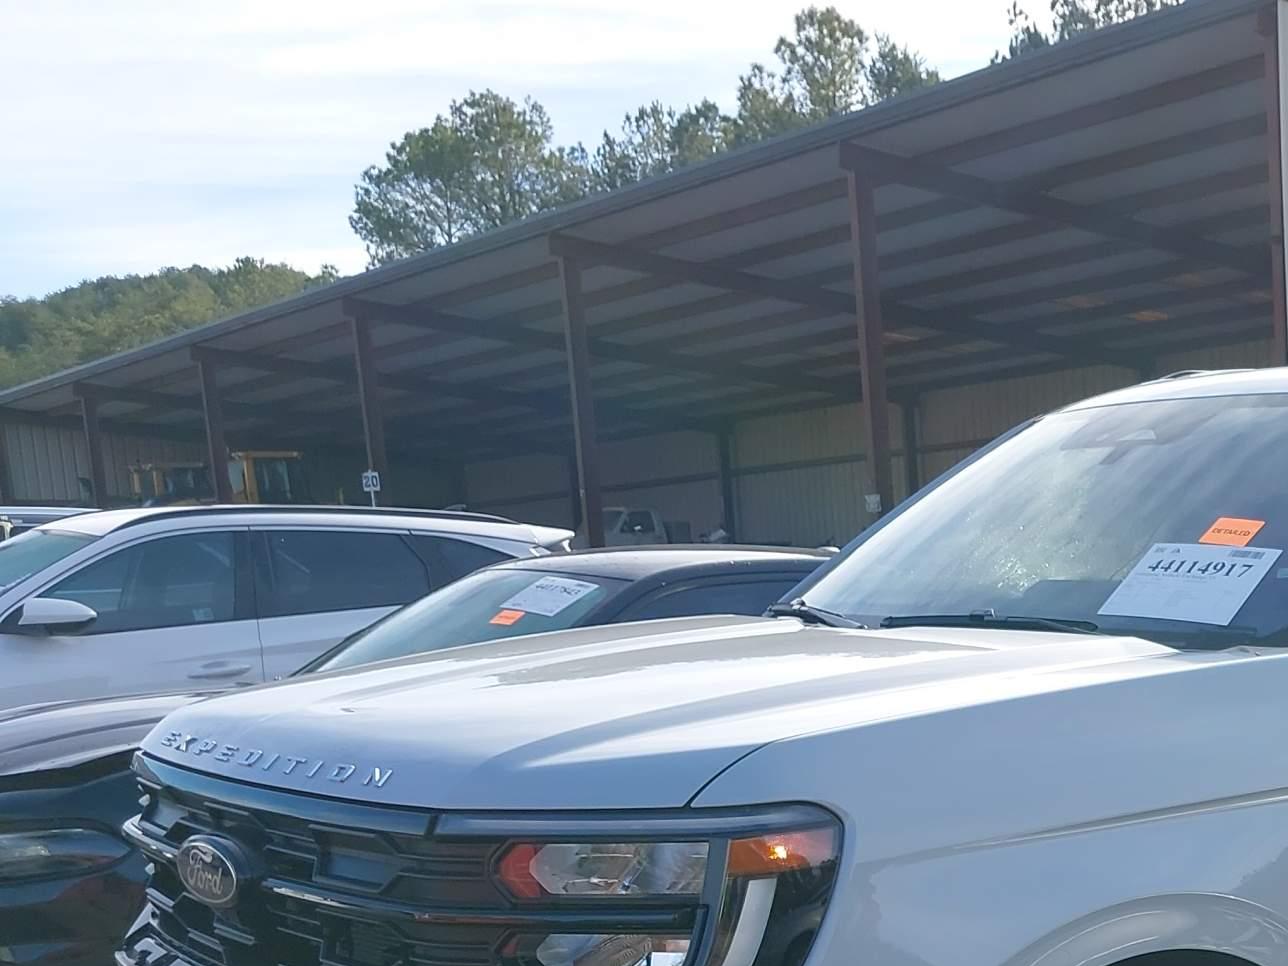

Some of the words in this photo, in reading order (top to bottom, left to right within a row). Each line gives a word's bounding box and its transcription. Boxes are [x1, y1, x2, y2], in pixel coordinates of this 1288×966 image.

[363, 475, 378, 488] 20
[1147, 559, 1256, 577] 44114917
[161, 730, 393, 788] EXPEDITION
[187, 848, 224, 894] Ford
